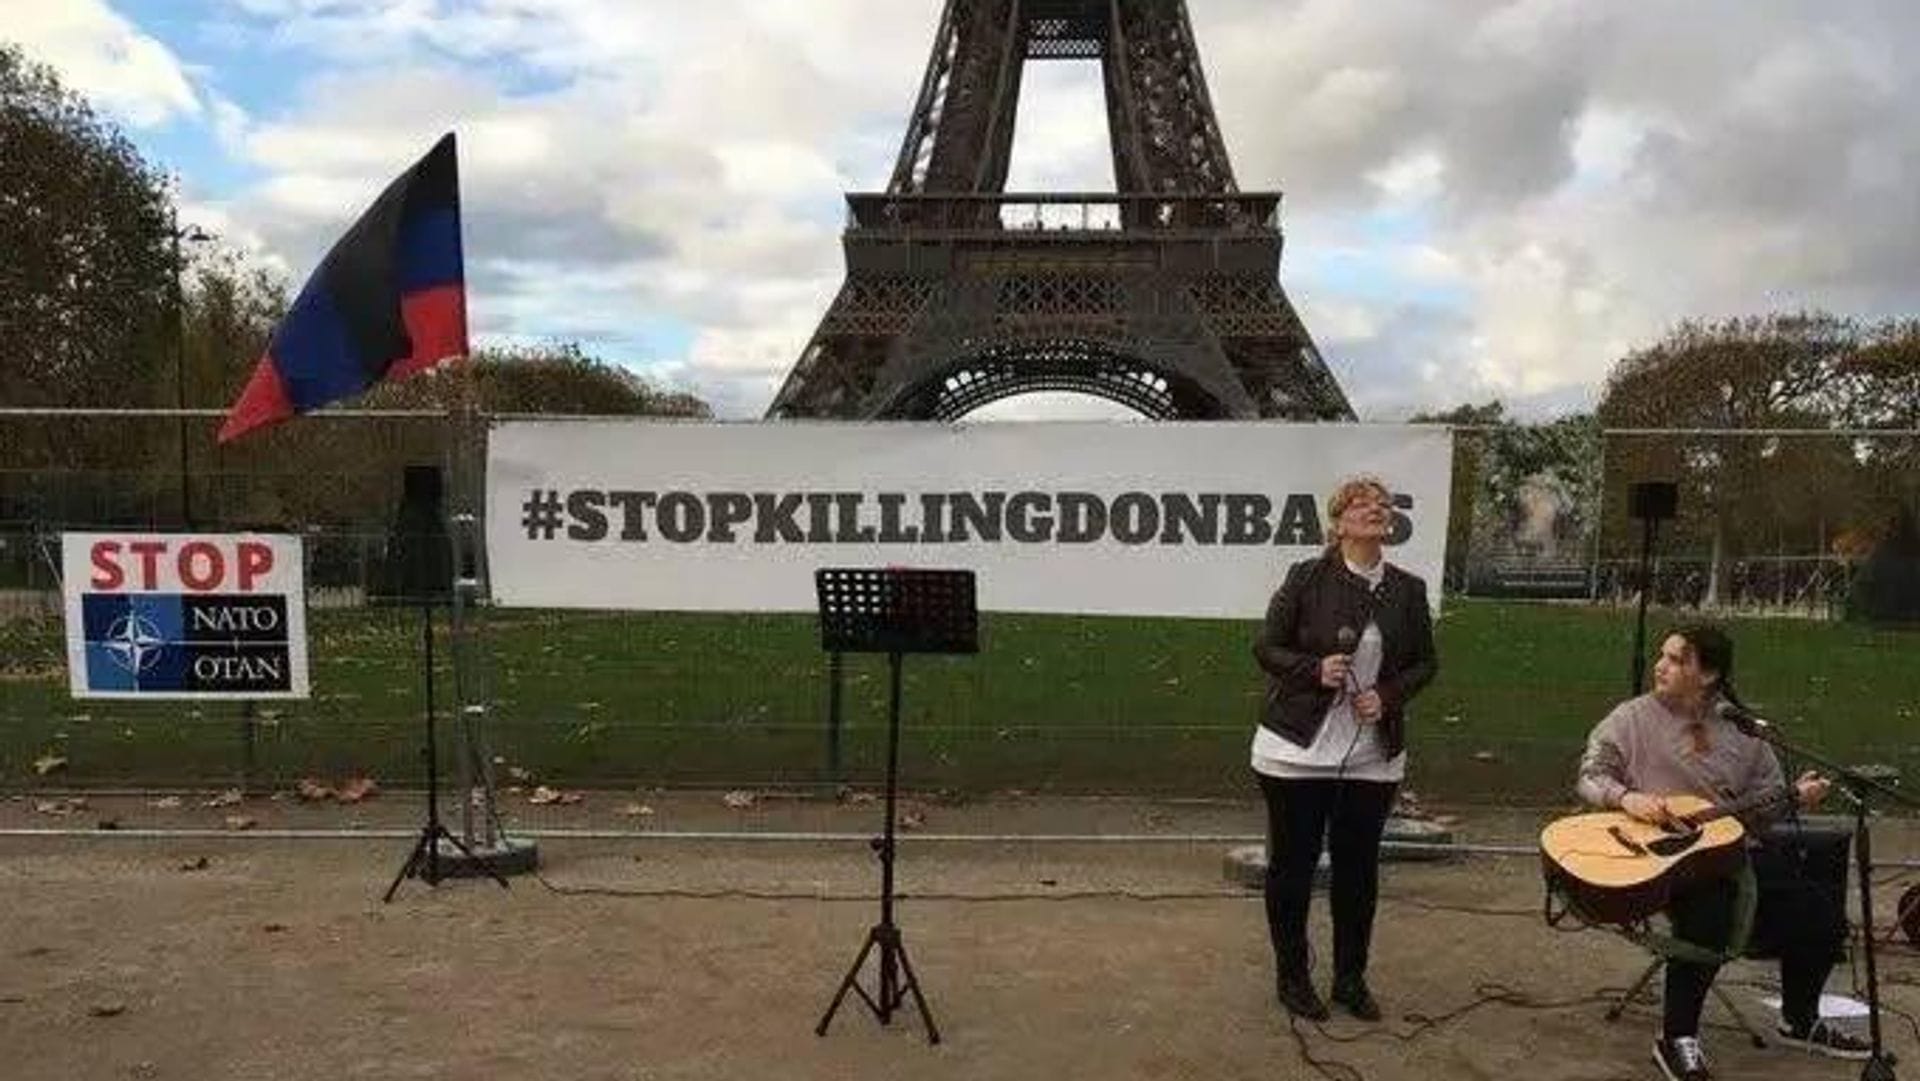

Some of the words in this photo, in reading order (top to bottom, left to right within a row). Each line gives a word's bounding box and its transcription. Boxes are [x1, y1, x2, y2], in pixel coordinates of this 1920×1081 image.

[522, 489, 1413, 546] #STOPKILLINGDONBAS
[90, 541, 274, 591] STOP
[193, 606, 278, 631] NATO
[194, 654, 280, 680] OTAN
